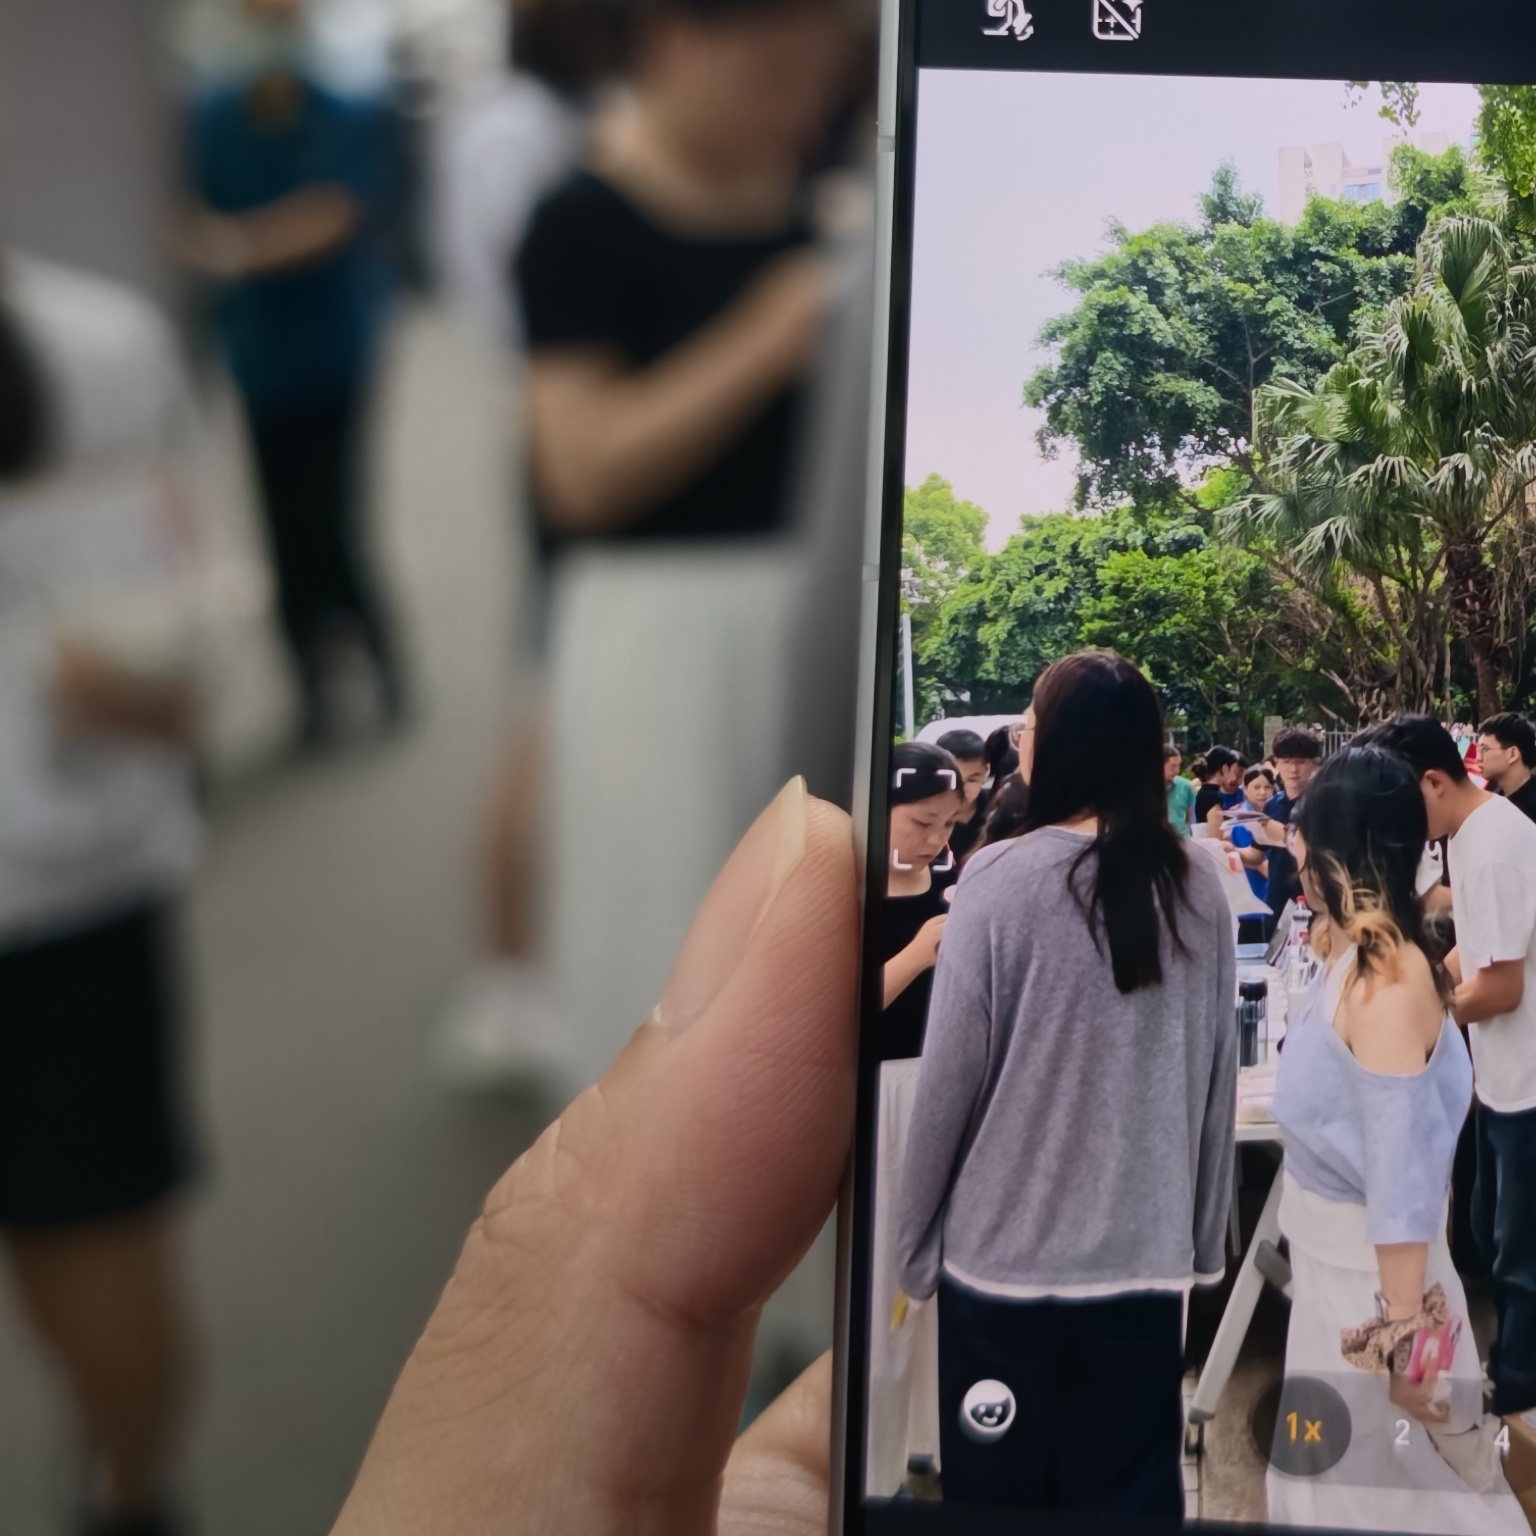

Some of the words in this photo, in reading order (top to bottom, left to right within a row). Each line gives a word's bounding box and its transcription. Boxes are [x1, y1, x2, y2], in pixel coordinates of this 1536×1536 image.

[1286, 1411, 1323, 1442] 1x
[1394, 1419, 1411, 1446] 2
[1493, 1424, 1511, 1453] 4
